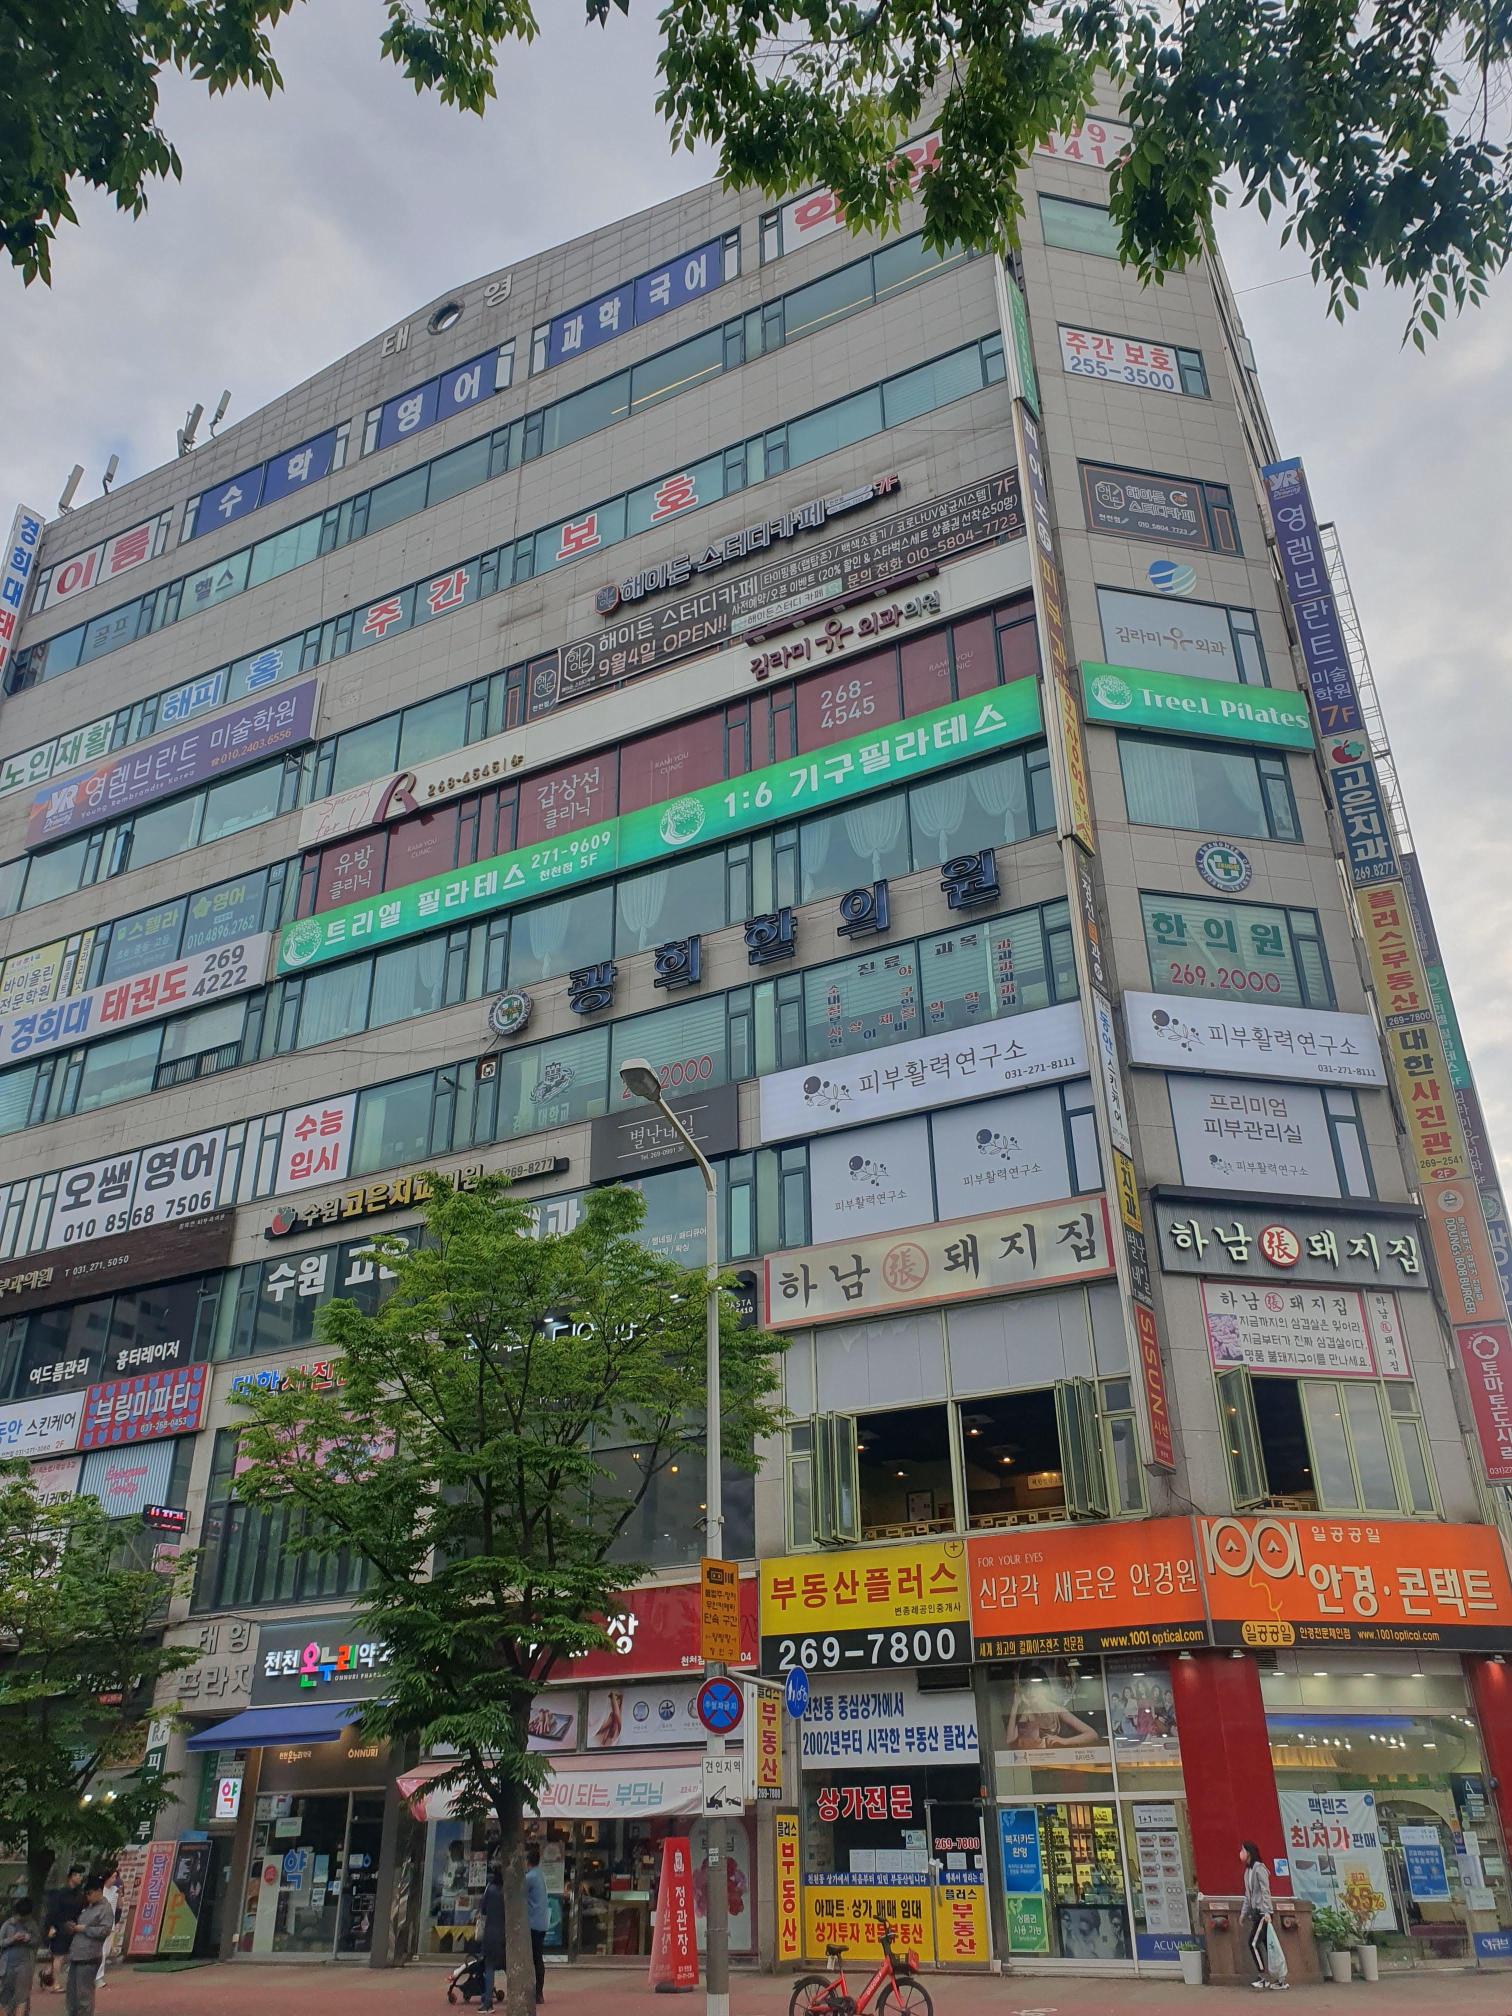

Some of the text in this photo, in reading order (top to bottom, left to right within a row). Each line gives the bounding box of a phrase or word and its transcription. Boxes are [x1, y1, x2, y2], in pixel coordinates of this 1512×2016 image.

[561, 254, 707, 354] 과학 국어
[1065, 331, 1174, 372] 주간 보호
[1069, 356, 1175, 391] 255-3500
[397, 366, 482, 432] 영어
[218, 448, 313, 518] 수학
[621, 472, 899, 602] 해이든 스터디카페 7F
[789, 574, 816, 592] 이벤트
[843, 556, 861, 573] 할인
[873, 529, 929, 561] 스타벅스세트
[931, 516, 960, 539] 상품권
[1, 515, 41, 609] 경희대
[56, 526, 151, 596] 이룸
[363, 473, 699, 637] 주간 보호
[599, 620, 655, 652] 해이든
[661, 575, 760, 630] 스터디카페
[993, 475, 1016, 496] 7F
[195, 568, 234, 602] 헬스
[598, 638, 656, 679] 9월4일
[848, 569, 873, 589] 문의
[876, 558, 902, 578] 전화
[906, 512, 1018, 565] 010-5804-7723
[1277, 505, 1339, 667] 영렘브란트
[750, 588, 941, 681] 김라미 외과의원
[1114, 625, 1230, 657] 김라미 외과
[162, 674, 222, 722] 해피
[820, 679, 874, 710] 268-
[821, 695, 875, 729] 4545
[1221, 698, 1309, 730] Pilates
[1320, 706, 1356, 729] 7F
[85, 696, 297, 807] 영렘브란트 미술학원
[723, 703, 1008, 818] 1:6 기구필라테스
[427, 762, 500, 797] 268-4545
[536, 767, 601, 808] 갑상선
[543, 798, 592, 830] 클리닉
[1338, 767, 1390, 863] 고은치과
[334, 844, 375, 876] 유방
[531, 831, 612, 867] 271-9609
[579, 854, 599, 872] 5F
[329, 870, 373, 900] 클리닉
[1353, 861, 1399, 882] 269.8277
[324, 864, 527, 947] 트리엘 필라테스
[127, 909, 179, 941] 스텔라
[187, 915, 255, 951] 010.4896.2762
[1151, 910, 1286, 958] 한의원
[203, 944, 245, 974] 269
[1367, 889, 1420, 1013] 플러스부동산
[4, 964, 55, 993] 바이올린
[191, 965, 248, 997] 4222
[1169, 962, 1281, 993] 269.2000
[10, 965, 190, 1054] 경희대 태권도
[1387, 1010, 1431, 1026] 269-7800
[1207, 1023, 1360, 1057] 피부활력연구소
[858, 1039, 1029, 1095] 피부활력연구소
[1004, 1056, 1077, 1081] 031-271-8111
[1317, 1063, 1377, 1078] 031-271-8111
[1209, 1093, 1288, 1119] 프리미엄
[1398, 1029, 1455, 1156] 대한사진관
[293, 1109, 344, 1143] 수능
[1203, 1117, 1305, 1146] 피부관리실
[60, 1137, 218, 1213] 오쌤 영어
[289, 1142, 340, 1181] 입시
[962, 1163, 1043, 1187] 피부활력연구소
[1235, 1159, 1310, 1177] 피부활력연구소
[1419, 1155, 1464, 1171] 269-2541
[1436, 1167, 1453, 1178] 2F
[63, 1190, 212, 1243] 010 8568 7506
[300, 1197, 342, 1227] 수원
[835, 1189, 908, 1212] 피부활력연구소
[778, 1212, 1097, 1308] 하남 돼지집
[1170, 1219, 1253, 1262] 하남
[1305, 1229, 1420, 1274] 돼지집
[266, 1253, 329, 1302] 수원
[1219, 1290, 1348, 1316] 하남 돼지집
[1238, 1315, 1331, 1332] 지금까지의 삼겹살은
[1241, 1333, 1291, 1347] 지금부터가
[29, 1357, 90, 1386] 여드름관리
[116, 1339, 181, 1371] 흉터레이저
[1139, 1312, 1166, 1418] SISUN
[1243, 1349, 1265, 1363] 명품
[94, 1382, 191, 1426] 브링미파티
[25, 1411, 77, 1438] 스킨케어
[1201, 1517, 1305, 1578] 1001
[1311, 1525, 1382, 1545] 일공공일
[977, 1552, 1044, 1568] FOR YOUR EYES
[770, 1561, 959, 1613] 부동산플러스
[978, 1557, 1199, 1610] 신감각 새로운 안경원
[778, 1627, 957, 1671] 269-7800
[1244, 1623, 1294, 1643] 일공공일
[838, 1691, 905, 1720] 중심상가에서
[347, 1748, 379, 1759] ONNURI
[761, 1702, 779, 1785] 부동산
[803, 1724, 979, 1756] 2002년부터 시작한 부동산 플러스
[705, 1760, 742, 1774] 견인지역
[222, 1780, 240, 1810] 약
[615, 1782, 664, 1806] 부모님
[816, 1784, 913, 1822] 상가전문
[1307, 1797, 1349, 1816] 팩렌즈
[777, 1821, 798, 1838] 플러스
[934, 1837, 980, 1850] 269-7800
[1352, 1831, 1377, 1850] 판매
[781, 1842, 798, 1952] 부동산
[900, 1898, 923, 1920] 임대
[945, 1888, 978, 1901] 플러스
[675, 1885, 689, 1957] 정관장
[814, 1921, 860, 1944] 상가투자
[952, 1903, 977, 1955] 부동산
